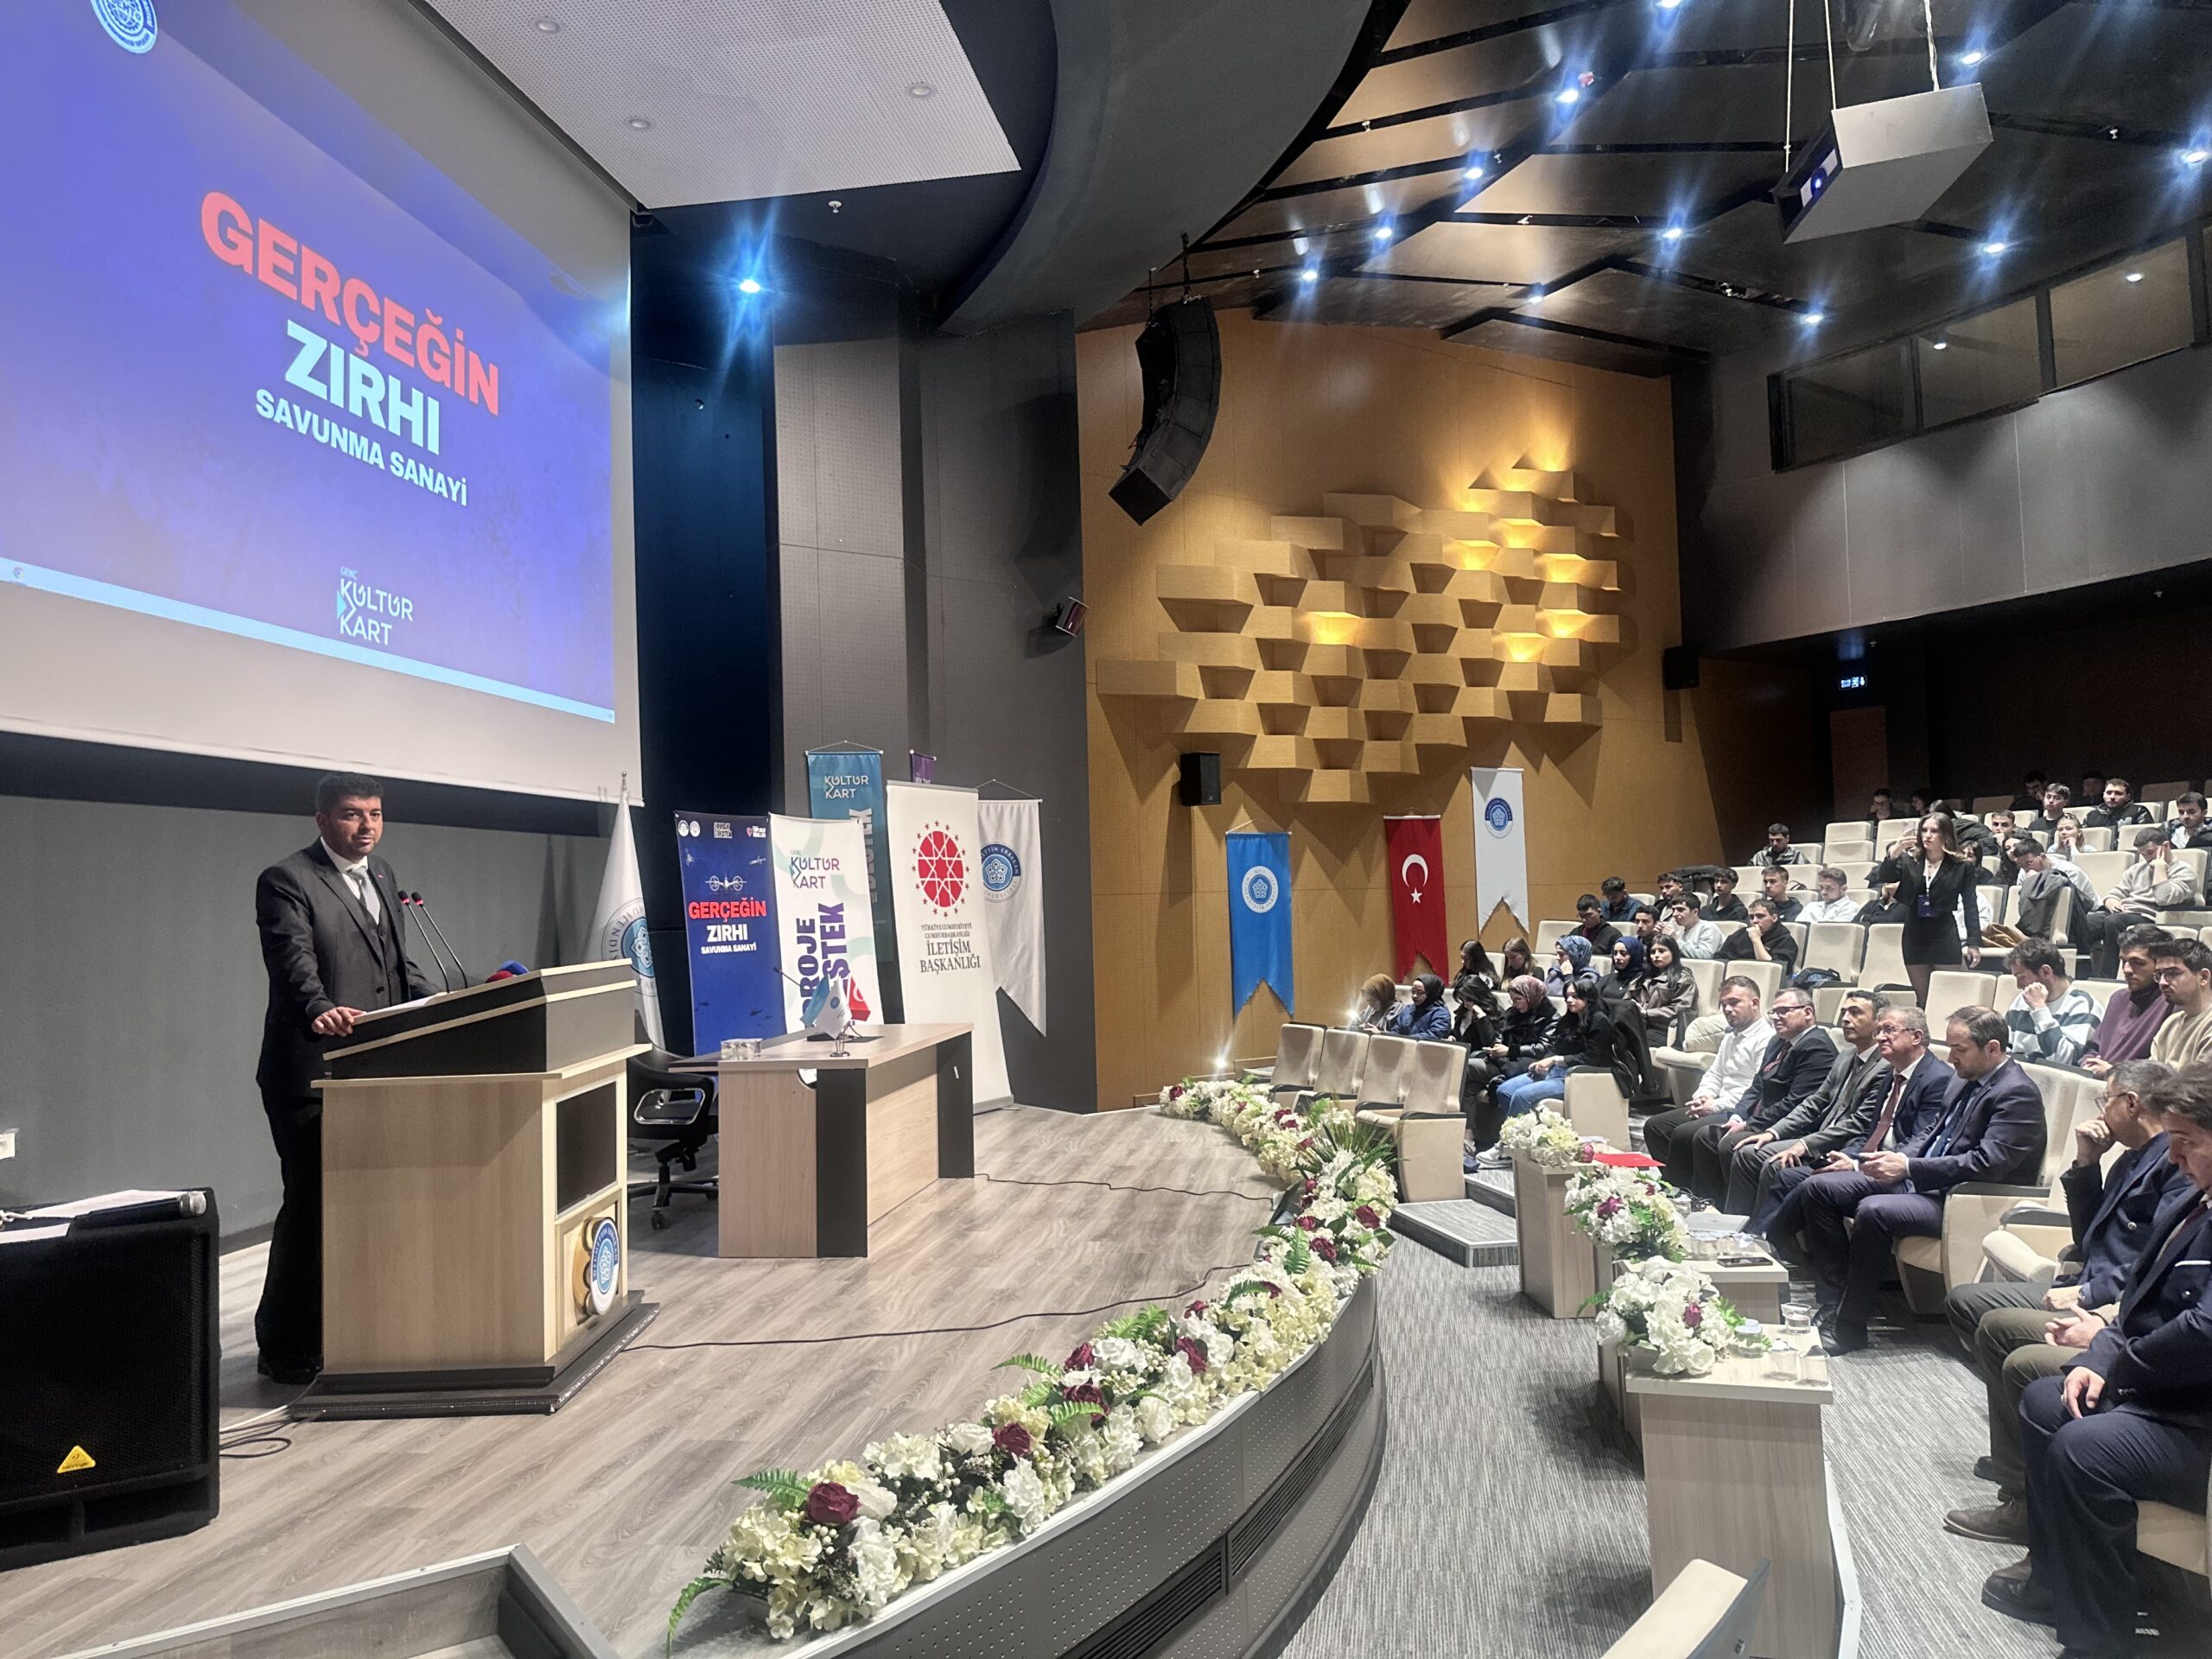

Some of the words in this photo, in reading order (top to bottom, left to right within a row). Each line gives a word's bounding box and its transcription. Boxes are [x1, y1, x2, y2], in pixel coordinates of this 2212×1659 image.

[201, 191, 499, 416] GERÇEĞİN
[285, 319, 440, 455] ZIRHI
[256, 388, 385, 471] SAVUNMA
[390, 450, 467, 507] SANAYİ
[340, 614, 392, 645] KART
[825, 788, 856, 798] KART
[792, 875, 826, 889] KART
[688, 897, 767, 923] GERÇEĞİN
[706, 924, 748, 943] ZIRHI
[941, 922, 972, 931] CUMHURİYETİ
[700, 944, 733, 955] SAVUNMA
[733, 941, 757, 953] SANAYİ
[926, 938, 971, 957] İLETİŞİM
[919, 953, 982, 975] BAŞKANLIĞI
